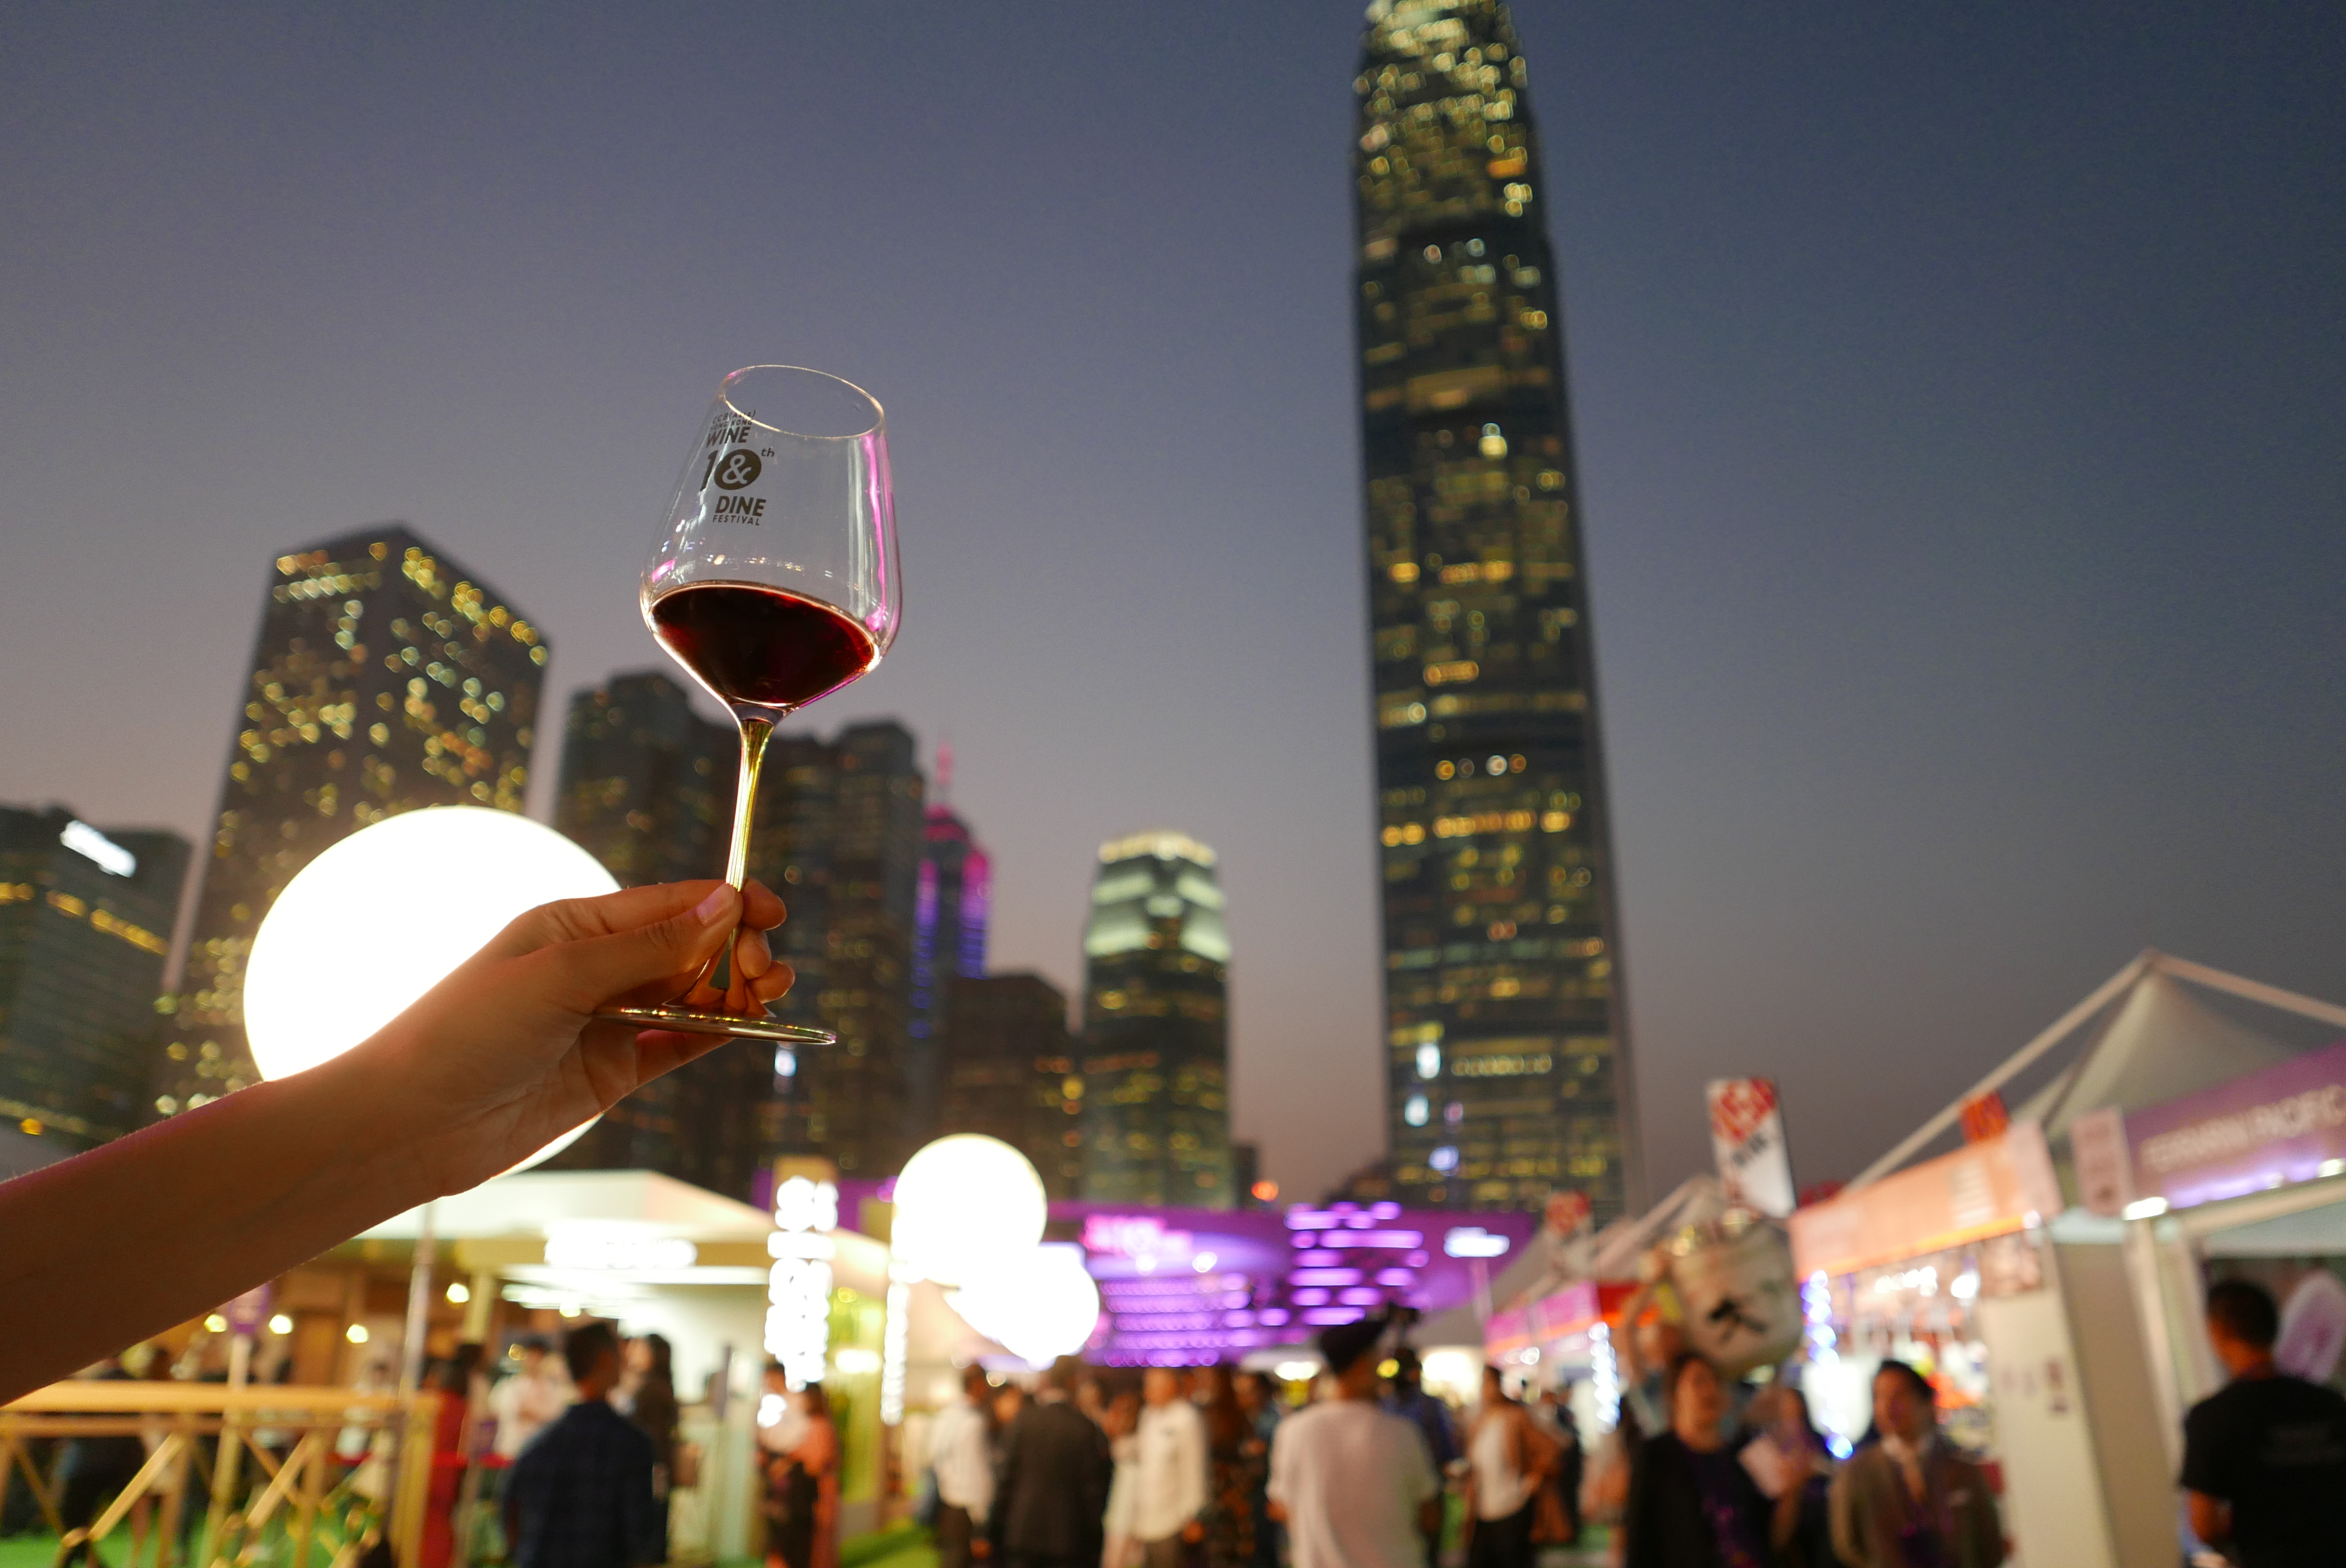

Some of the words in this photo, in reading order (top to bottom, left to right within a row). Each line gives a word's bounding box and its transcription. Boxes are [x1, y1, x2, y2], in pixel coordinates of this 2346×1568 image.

[706, 427, 751, 447] WINE
[715, 495, 767, 517] DINE
[712, 514, 760, 526] FESTIVAL
